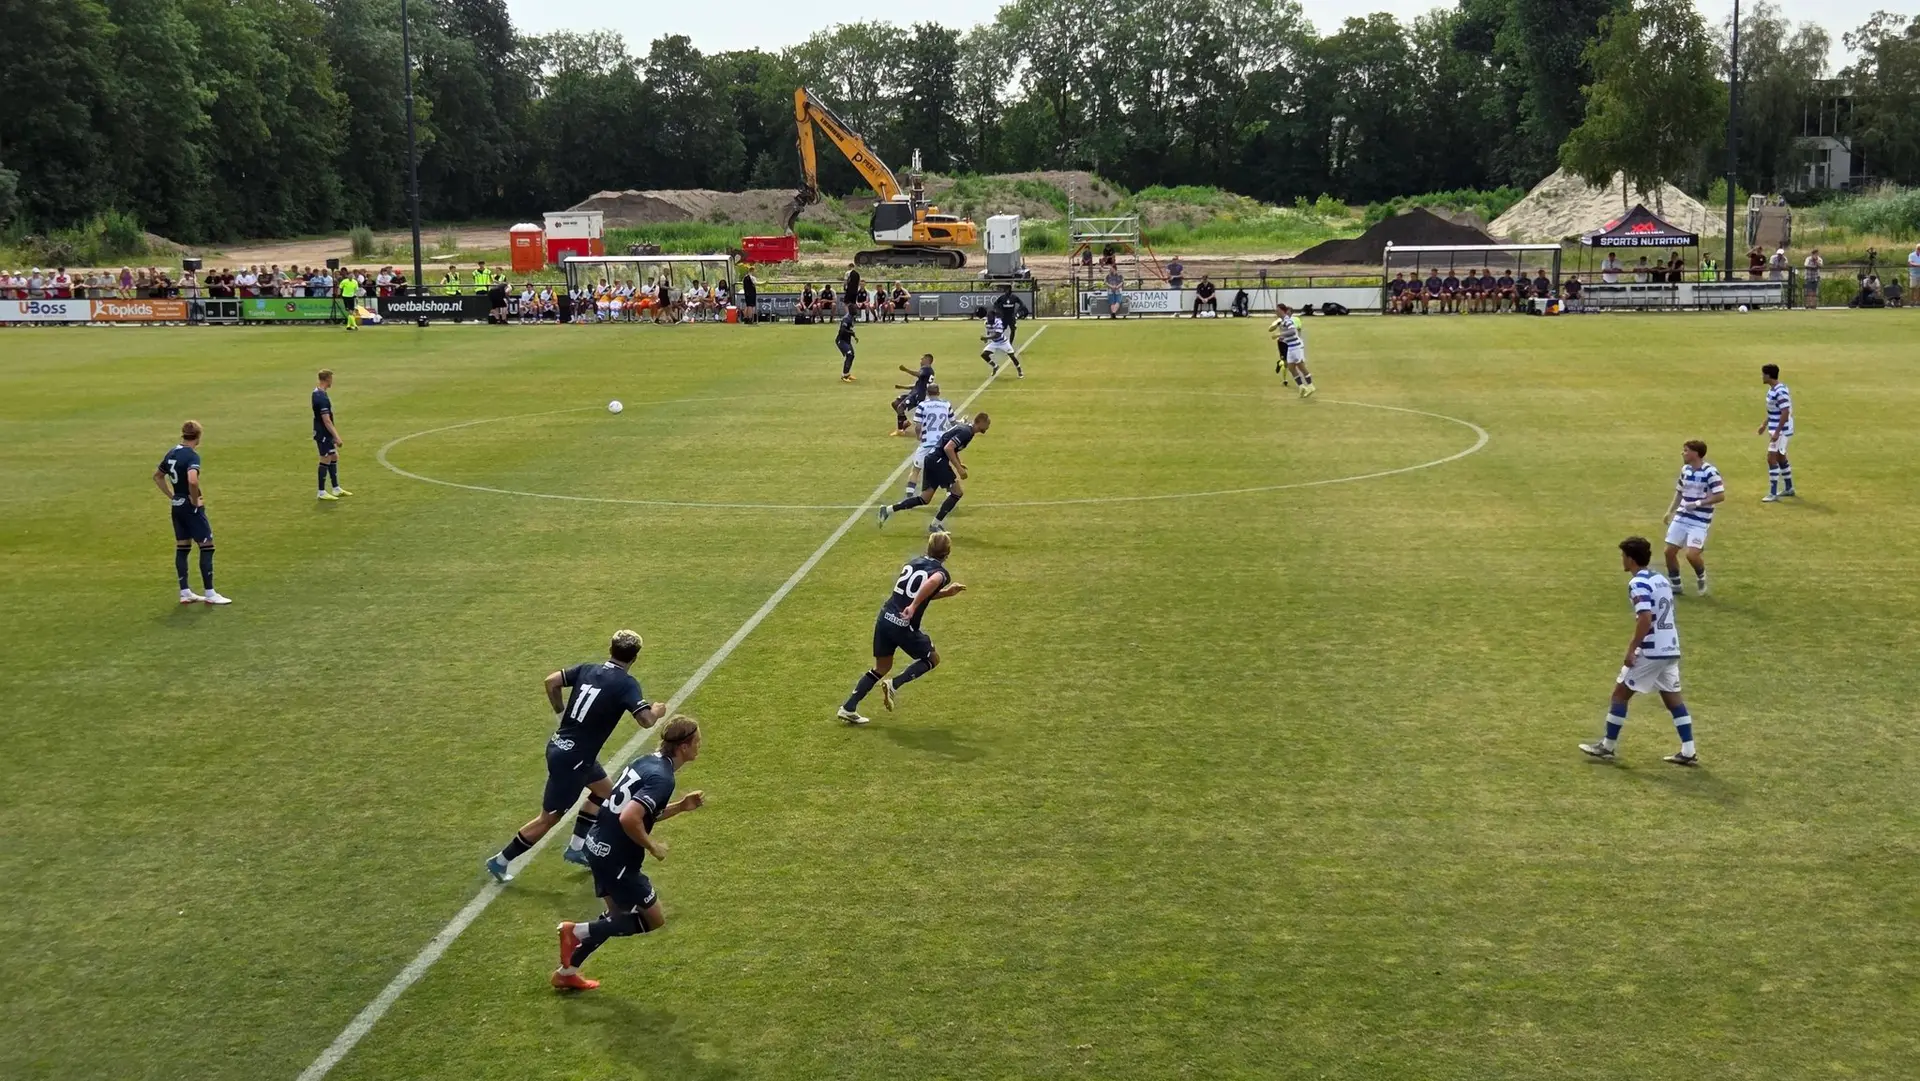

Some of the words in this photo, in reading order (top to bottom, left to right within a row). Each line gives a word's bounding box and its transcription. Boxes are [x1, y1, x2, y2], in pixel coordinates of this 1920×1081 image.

[1600, 237, 1638, 246] SPORTS
[1640, 236, 1690, 245] NUTRITION
[107, 303, 153, 318] Topkids
[387, 300, 462, 313] voetbalshop.nl
[1130, 301, 1168, 309] WADVIES
[927, 412, 947, 431] 22
[167, 459, 178, 484] 3
[893, 565, 928, 599] 20
[570, 683, 602, 723] 11
